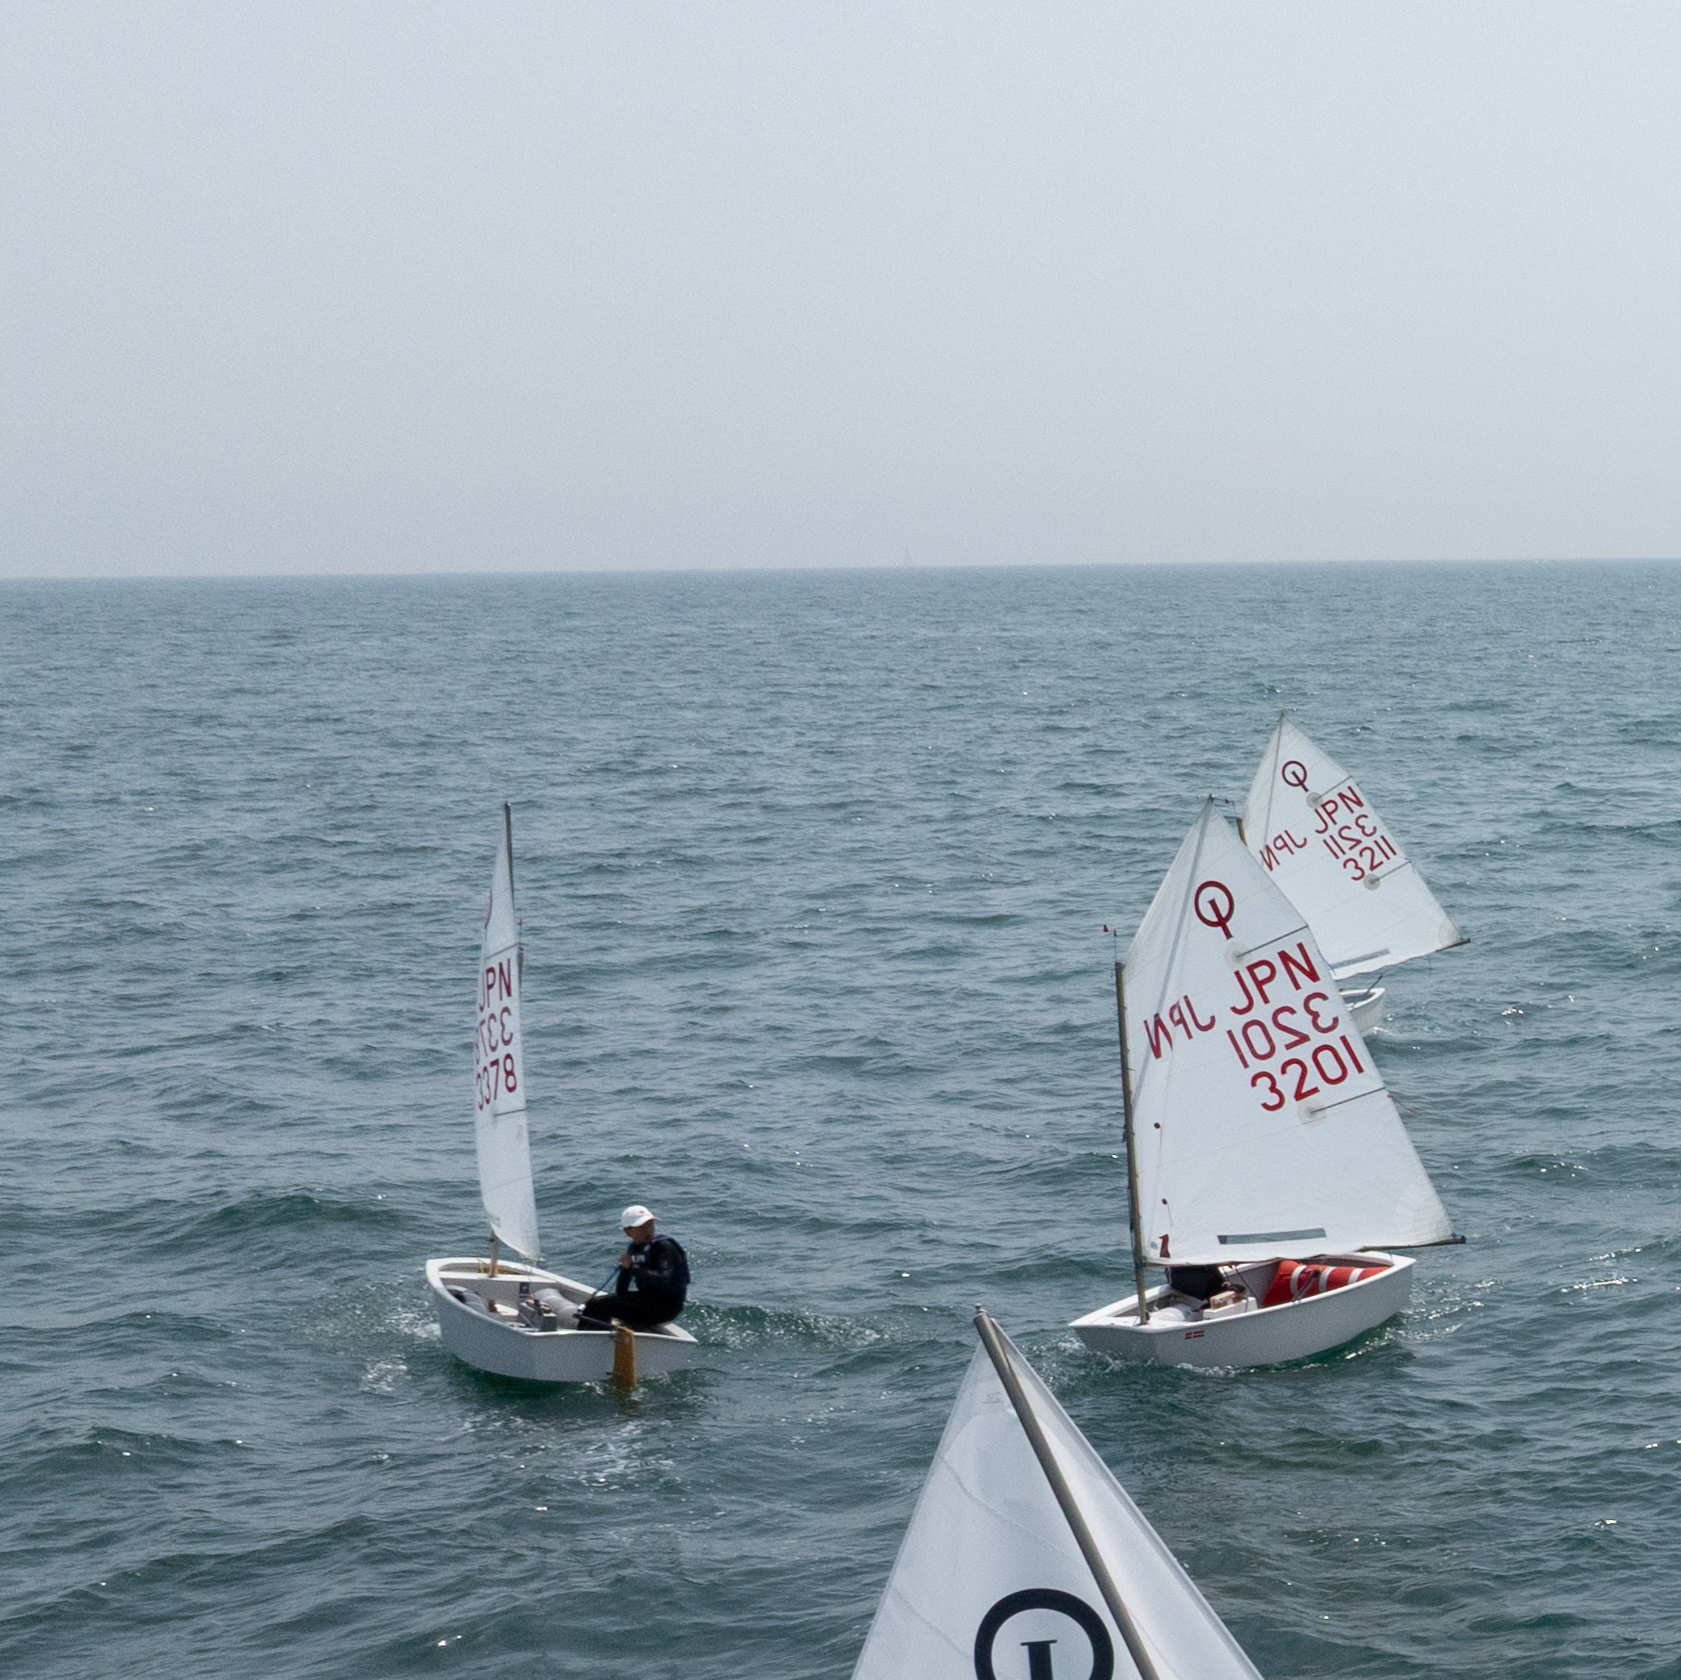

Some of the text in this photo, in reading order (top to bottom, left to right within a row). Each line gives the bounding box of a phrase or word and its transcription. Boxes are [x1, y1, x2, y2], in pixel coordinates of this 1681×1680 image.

[1315, 786, 1364, 834] JPN
[1343, 835, 1397, 881] 3211
[479, 958, 512, 1013] JPN
[1230, 942, 1321, 1015] JPN
[476, 1053, 517, 1111] 3378
[1251, 1035, 1365, 1112] 3201
